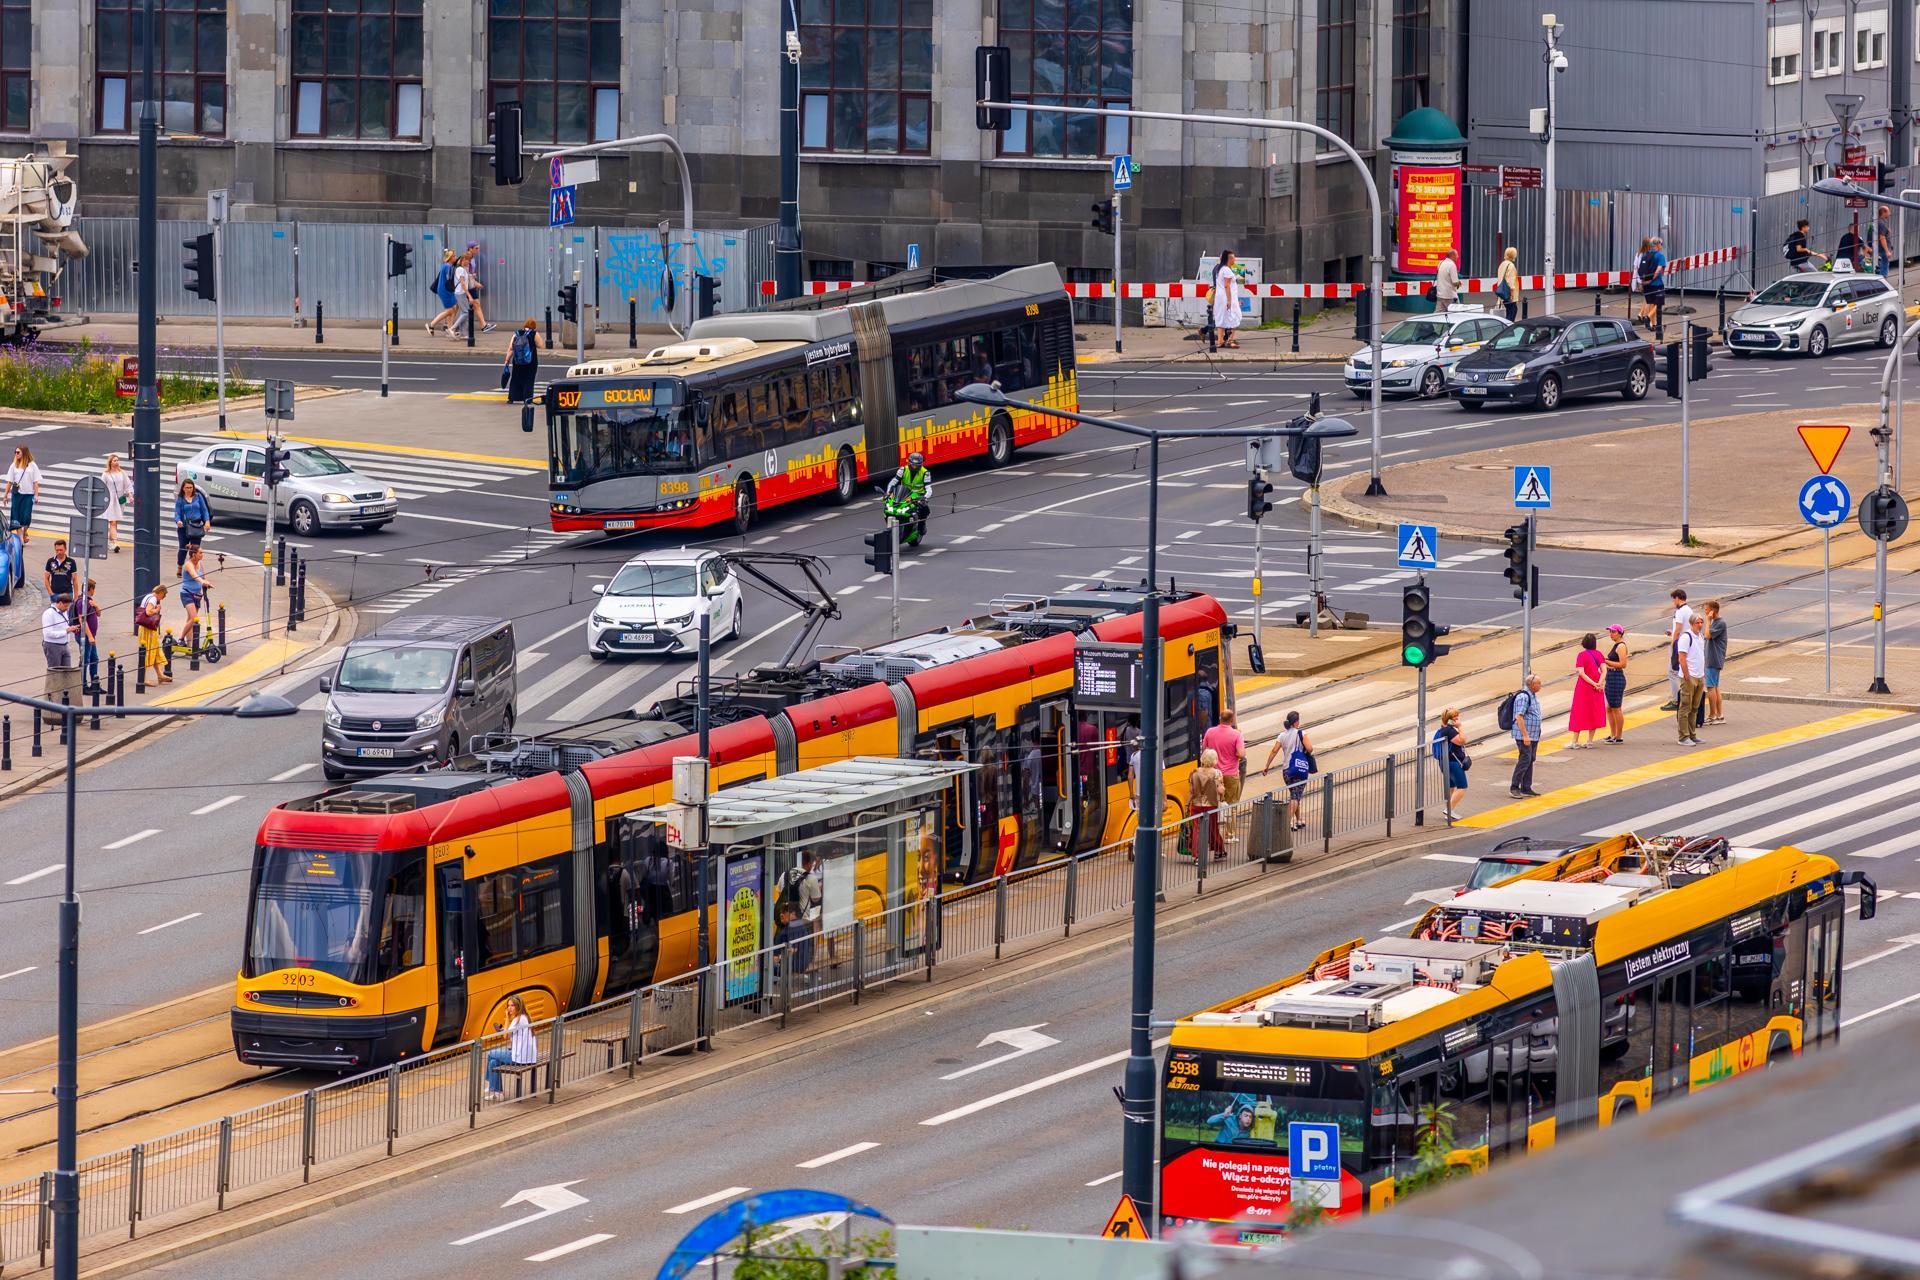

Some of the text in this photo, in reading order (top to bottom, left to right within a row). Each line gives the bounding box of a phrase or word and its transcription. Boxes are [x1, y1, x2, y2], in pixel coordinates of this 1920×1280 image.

[1840, 167, 1870, 177] Nowy Świat
[1862, 311, 1879, 325] Uber
[823, 342, 850, 357] hybrydowy
[119, 383, 137, 391] Nowy
[558, 391, 581, 407] 507
[660, 481, 688, 494] 8398
[732, 932, 755, 945] MONKEYS
[732, 944, 754, 957] KENDRICK
[1629, 940, 1690, 977] jestem elektryczny
[1170, 1061, 1199, 1076] 5938
[1301, 1130, 1328, 1172] P
[1202, 1158, 1290, 1175] Nie polegaj na progn
[1314, 1164, 1337, 1172] płatny
[1221, 1171, 1291, 1186] Włącz e-odczyt
